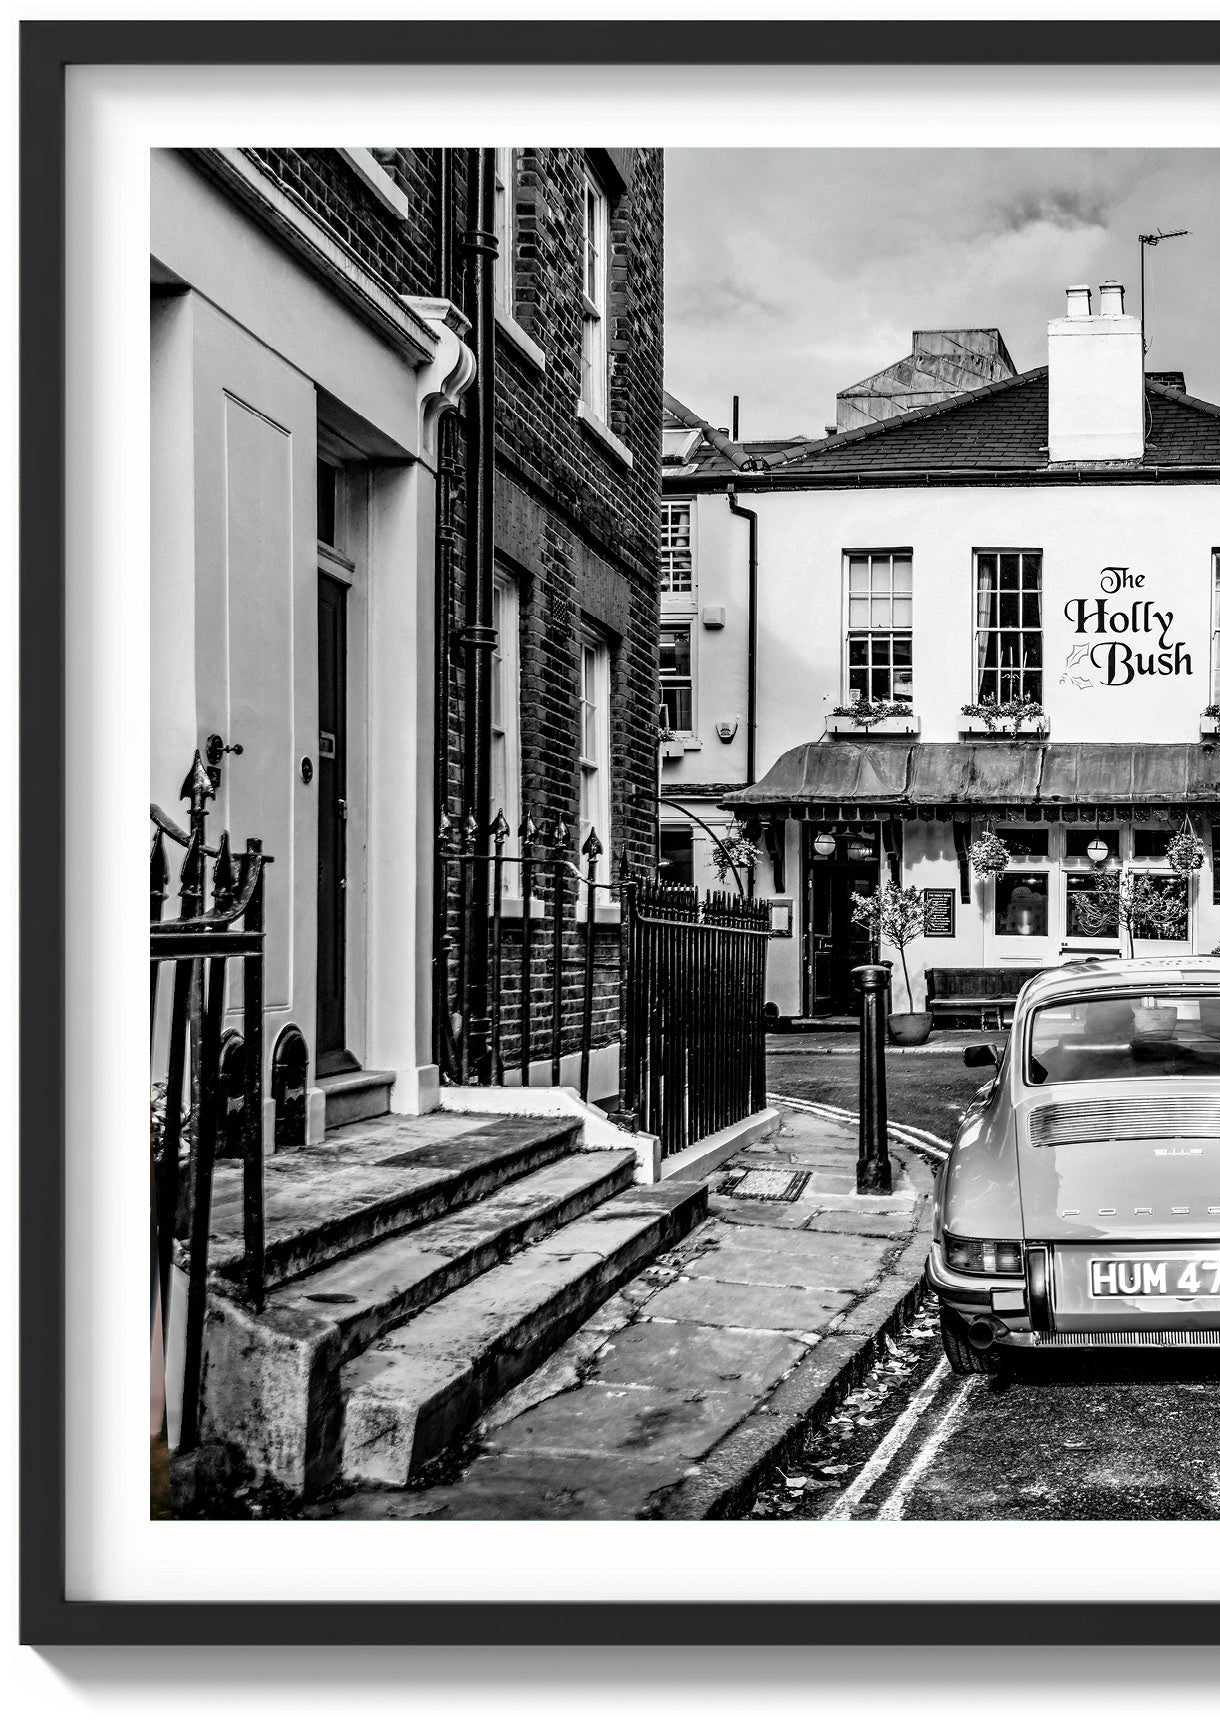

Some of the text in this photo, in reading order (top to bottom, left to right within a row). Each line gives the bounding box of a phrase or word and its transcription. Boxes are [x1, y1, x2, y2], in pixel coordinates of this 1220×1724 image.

[1100, 567, 1146, 594] The
[1064, 599, 1174, 650] Holly
[1090, 641, 1194, 686] Bush
[1093, 1262, 1167, 1294] HUM
